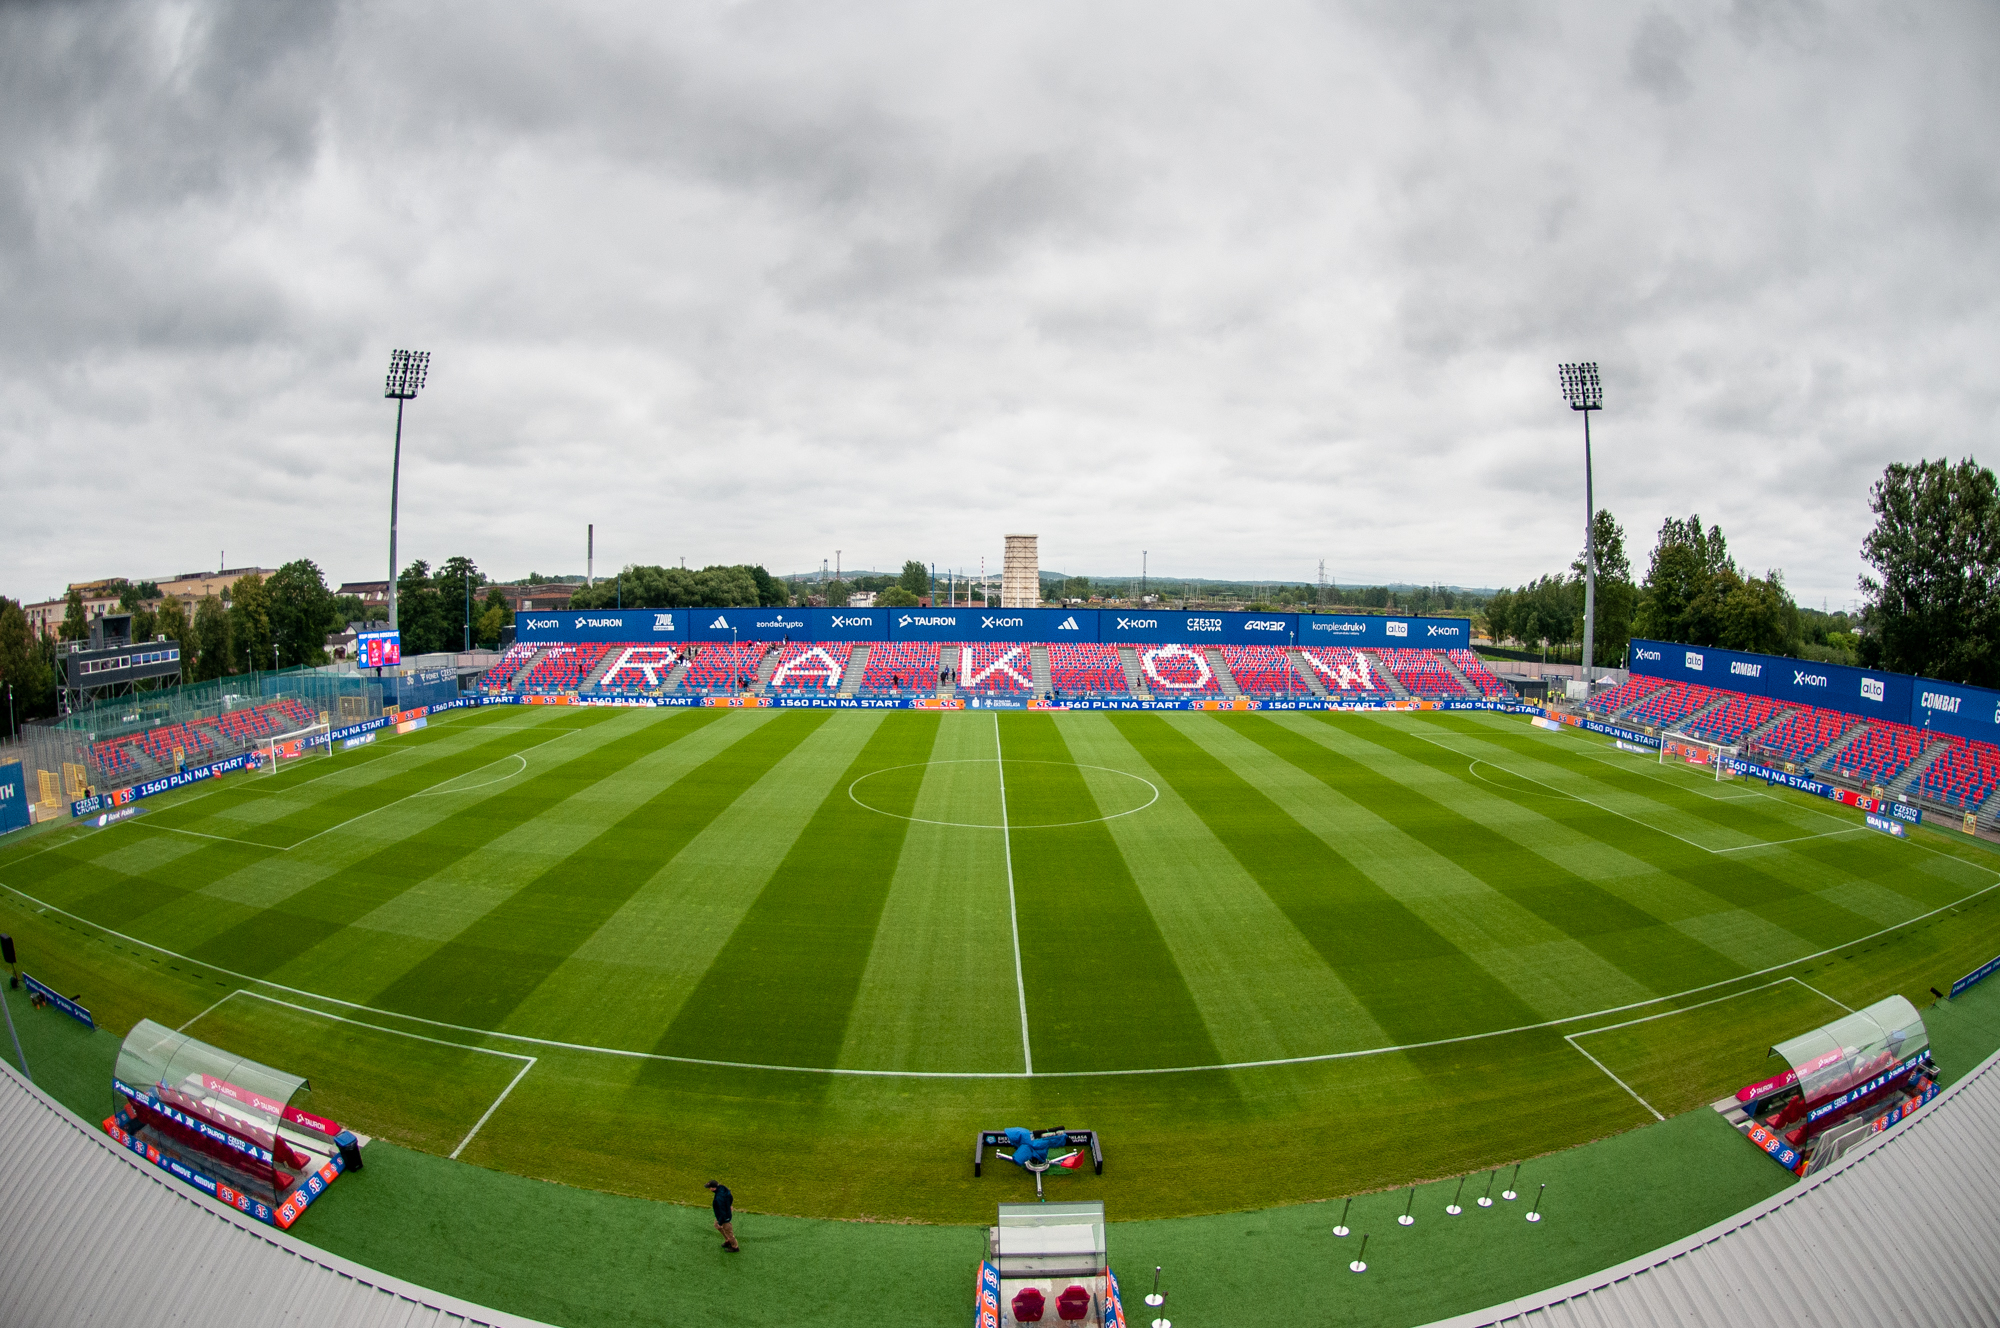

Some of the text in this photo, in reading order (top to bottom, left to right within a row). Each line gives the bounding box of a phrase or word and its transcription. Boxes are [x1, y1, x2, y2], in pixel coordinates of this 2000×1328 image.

[587, 619, 622, 627] TAURON
[756, 620, 804, 629] zondacrypto
[913, 617, 956, 626] TAURON
[1312, 621, 1360, 632] komplexdruk
[1730, 661, 1762, 678] COMBAT
[433, 701, 447, 712] 1560
[448, 698, 463, 708] PLN
[482, 696, 514, 704] START
[657, 698, 692, 706] START
[780, 699, 809, 707] 1560
[1060, 701, 1089, 709] 1560
[1093, 701, 1118, 709] PLN
[1142, 701, 1181, 709] START
[1920, 692, 1962, 714] COMBAT
[1515, 705, 1540, 715] START
[310, 719, 384, 746] 1560 PLN NA START
[1586, 722, 1660, 747] 1560 PLN NA START
[141, 779, 168, 796] 1560
[171, 771, 193, 786] PLN
[195, 767, 210, 780] NA
[211, 757, 243, 773] START
[1724, 759, 1823, 794] 1560 PLN NA START
[1866, 816, 1881, 828] GRAJ
[217, 1085, 237, 1098] TAURON
[1756, 1083, 1773, 1094] TAURON
[260, 1102, 280, 1114] TAURON
[304, 1118, 326, 1131] TAURON
[206, 1126, 225, 1141] TAURON
[282, 1177, 322, 1222] STS STS STS
